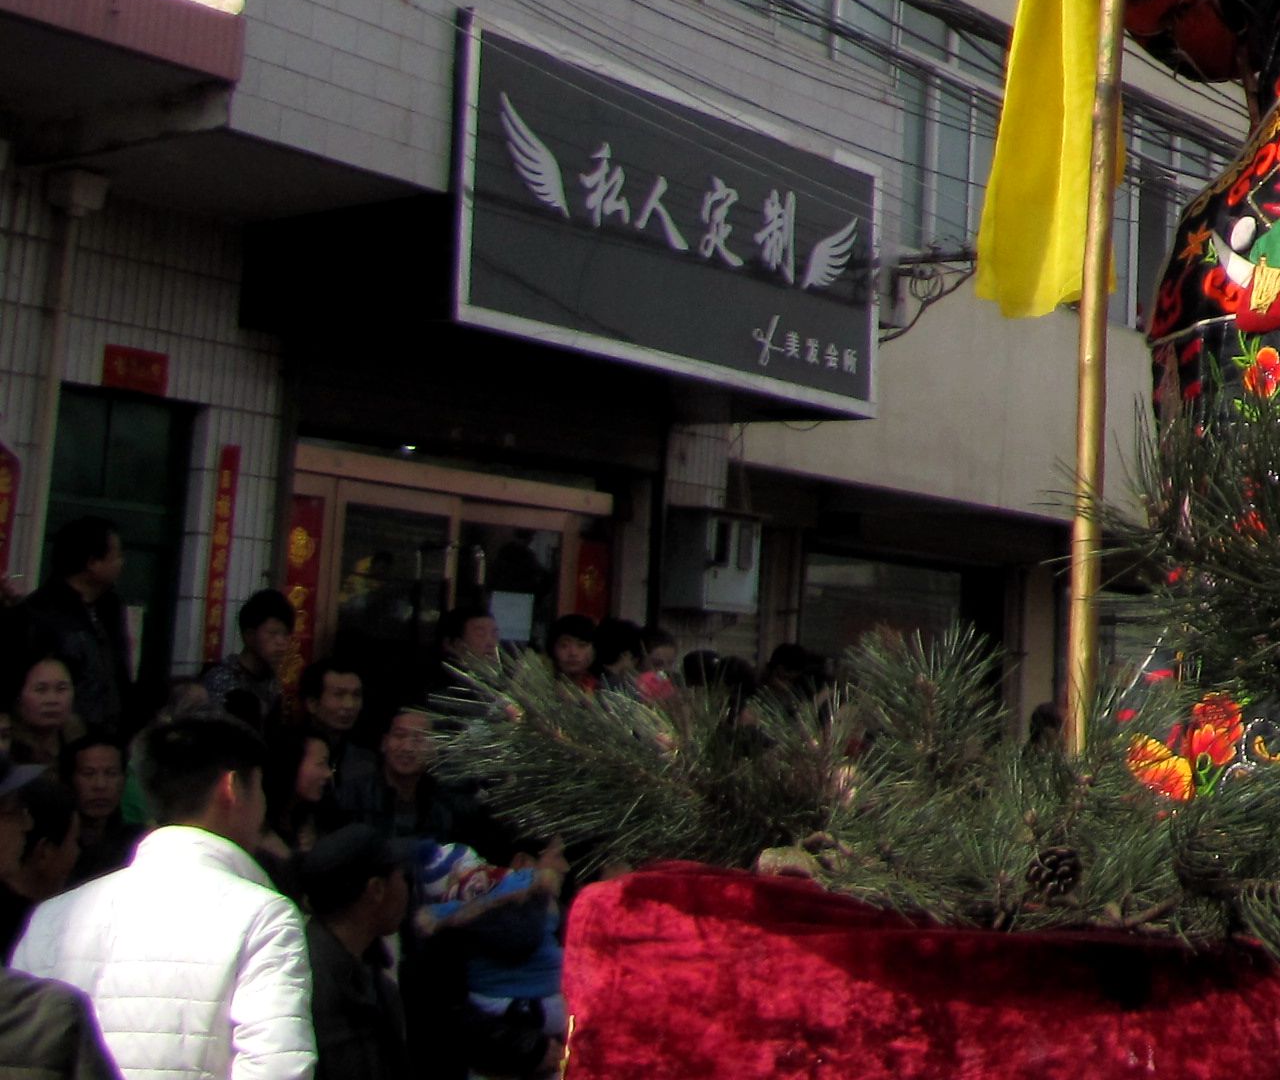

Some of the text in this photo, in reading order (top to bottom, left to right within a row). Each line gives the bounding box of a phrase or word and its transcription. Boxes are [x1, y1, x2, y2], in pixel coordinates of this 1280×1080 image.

[580, 142, 794, 284] 私人定制
[785, 330, 857, 375] 美发会所
